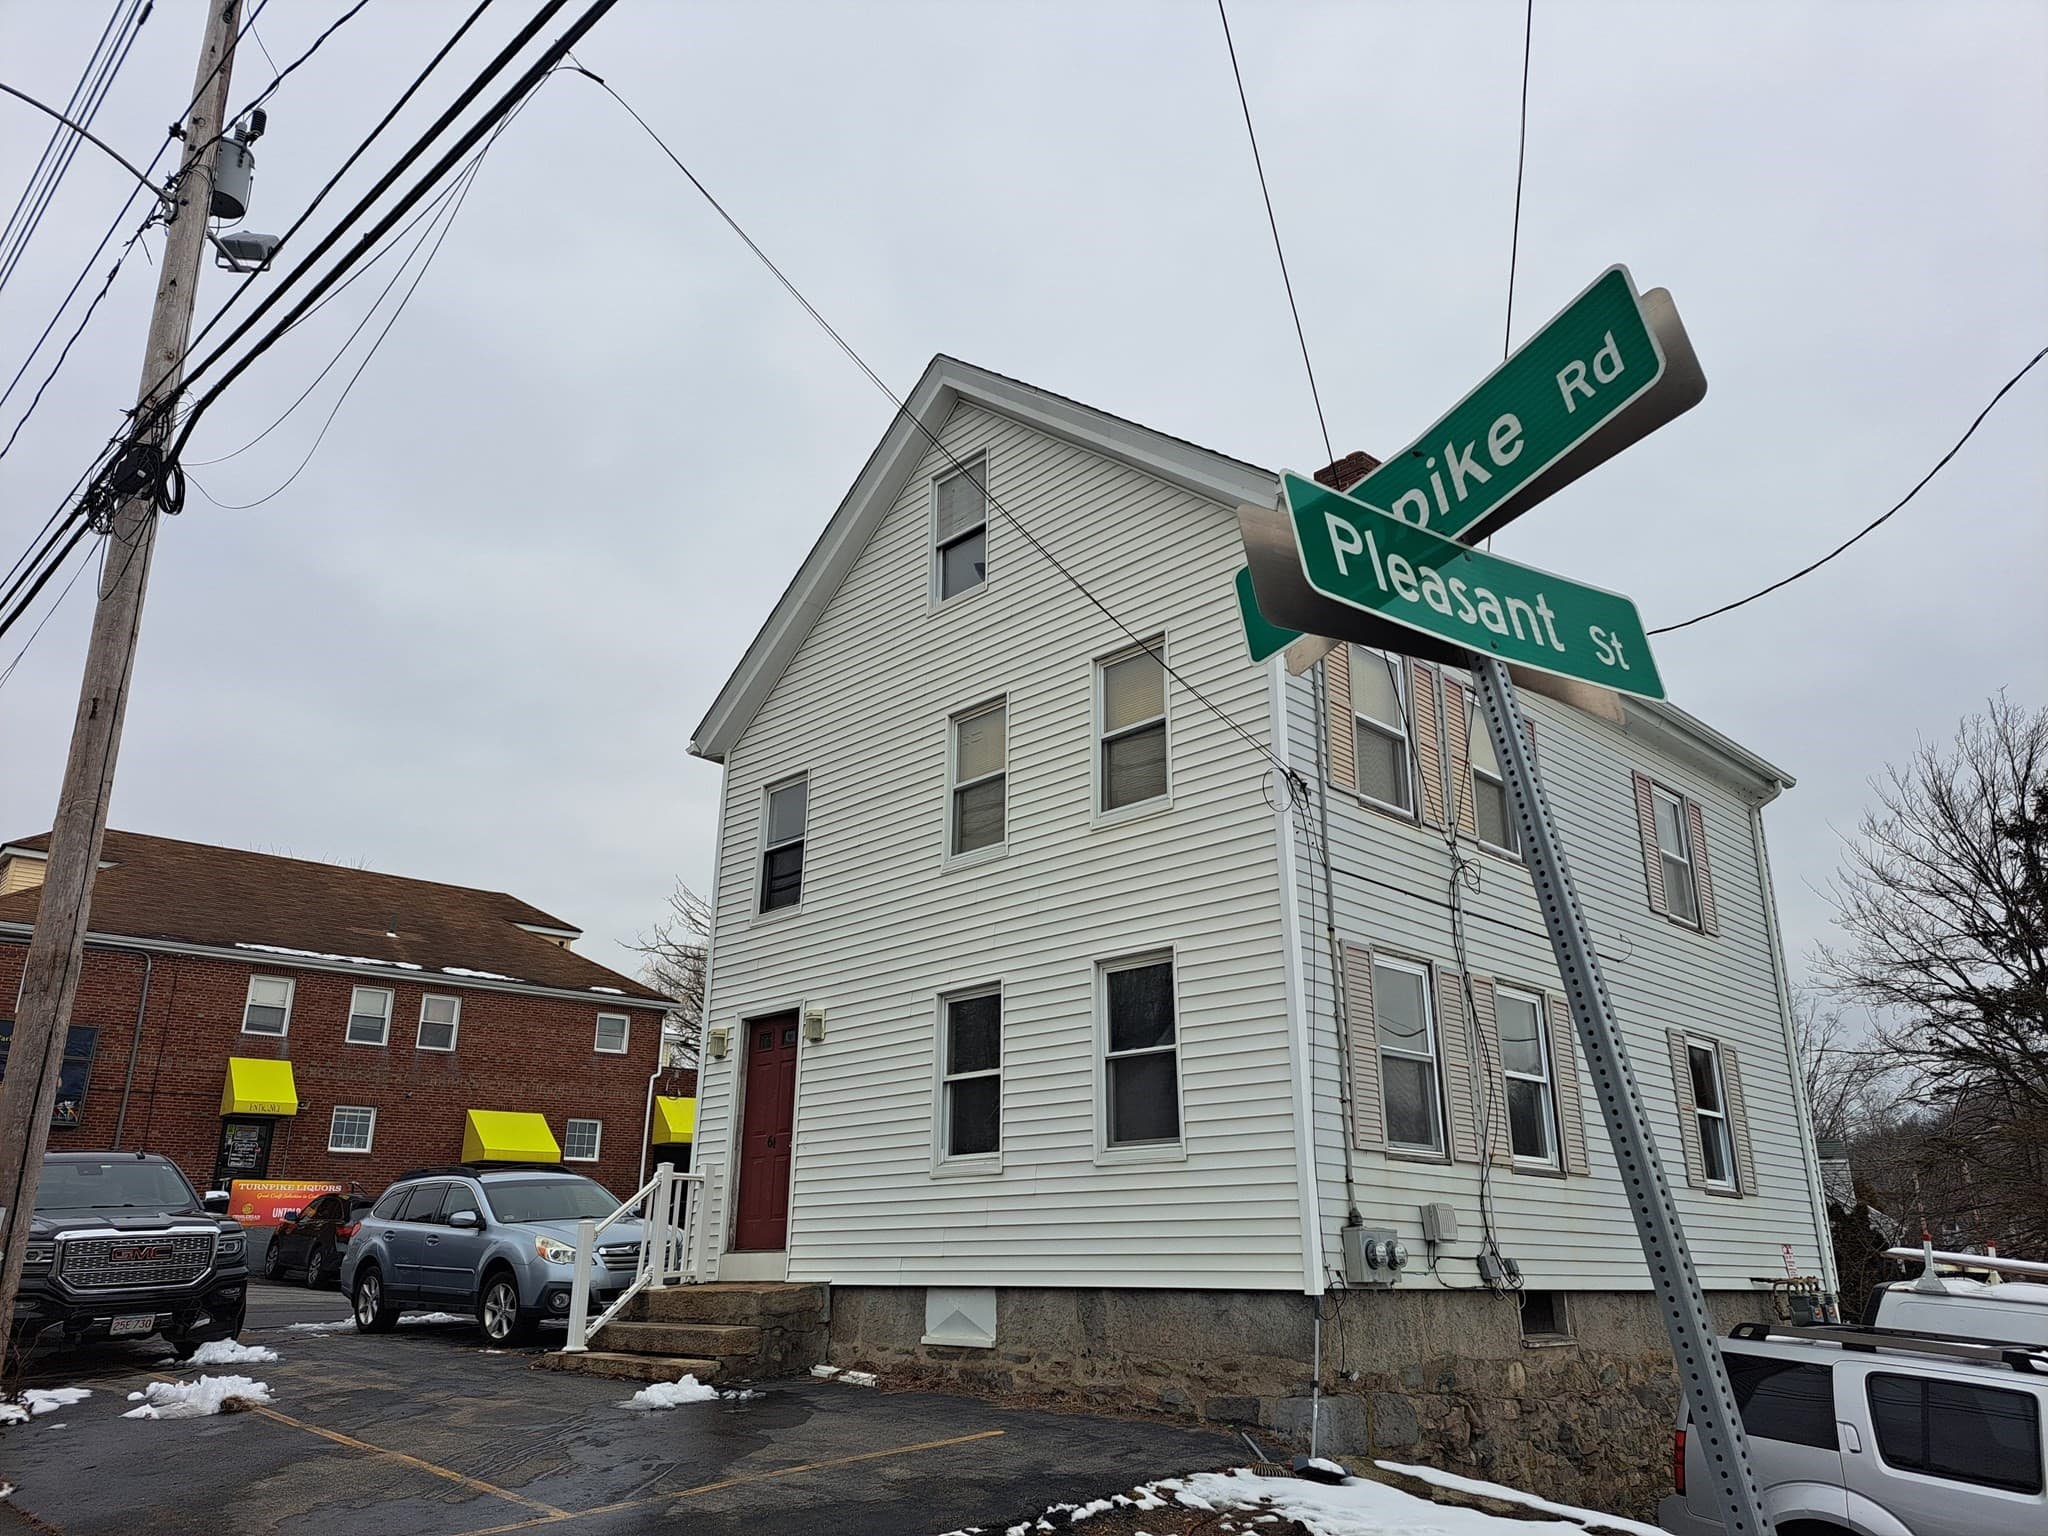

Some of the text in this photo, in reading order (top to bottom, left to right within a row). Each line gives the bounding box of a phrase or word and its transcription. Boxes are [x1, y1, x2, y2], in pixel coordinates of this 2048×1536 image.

[1555, 329, 1626, 414] Rd
[1323, 511, 1631, 671] Pleasant St
[238, 1183, 343, 1193] TURNPIKE LIQUORS
[112, 1245, 172, 1261] GMC
